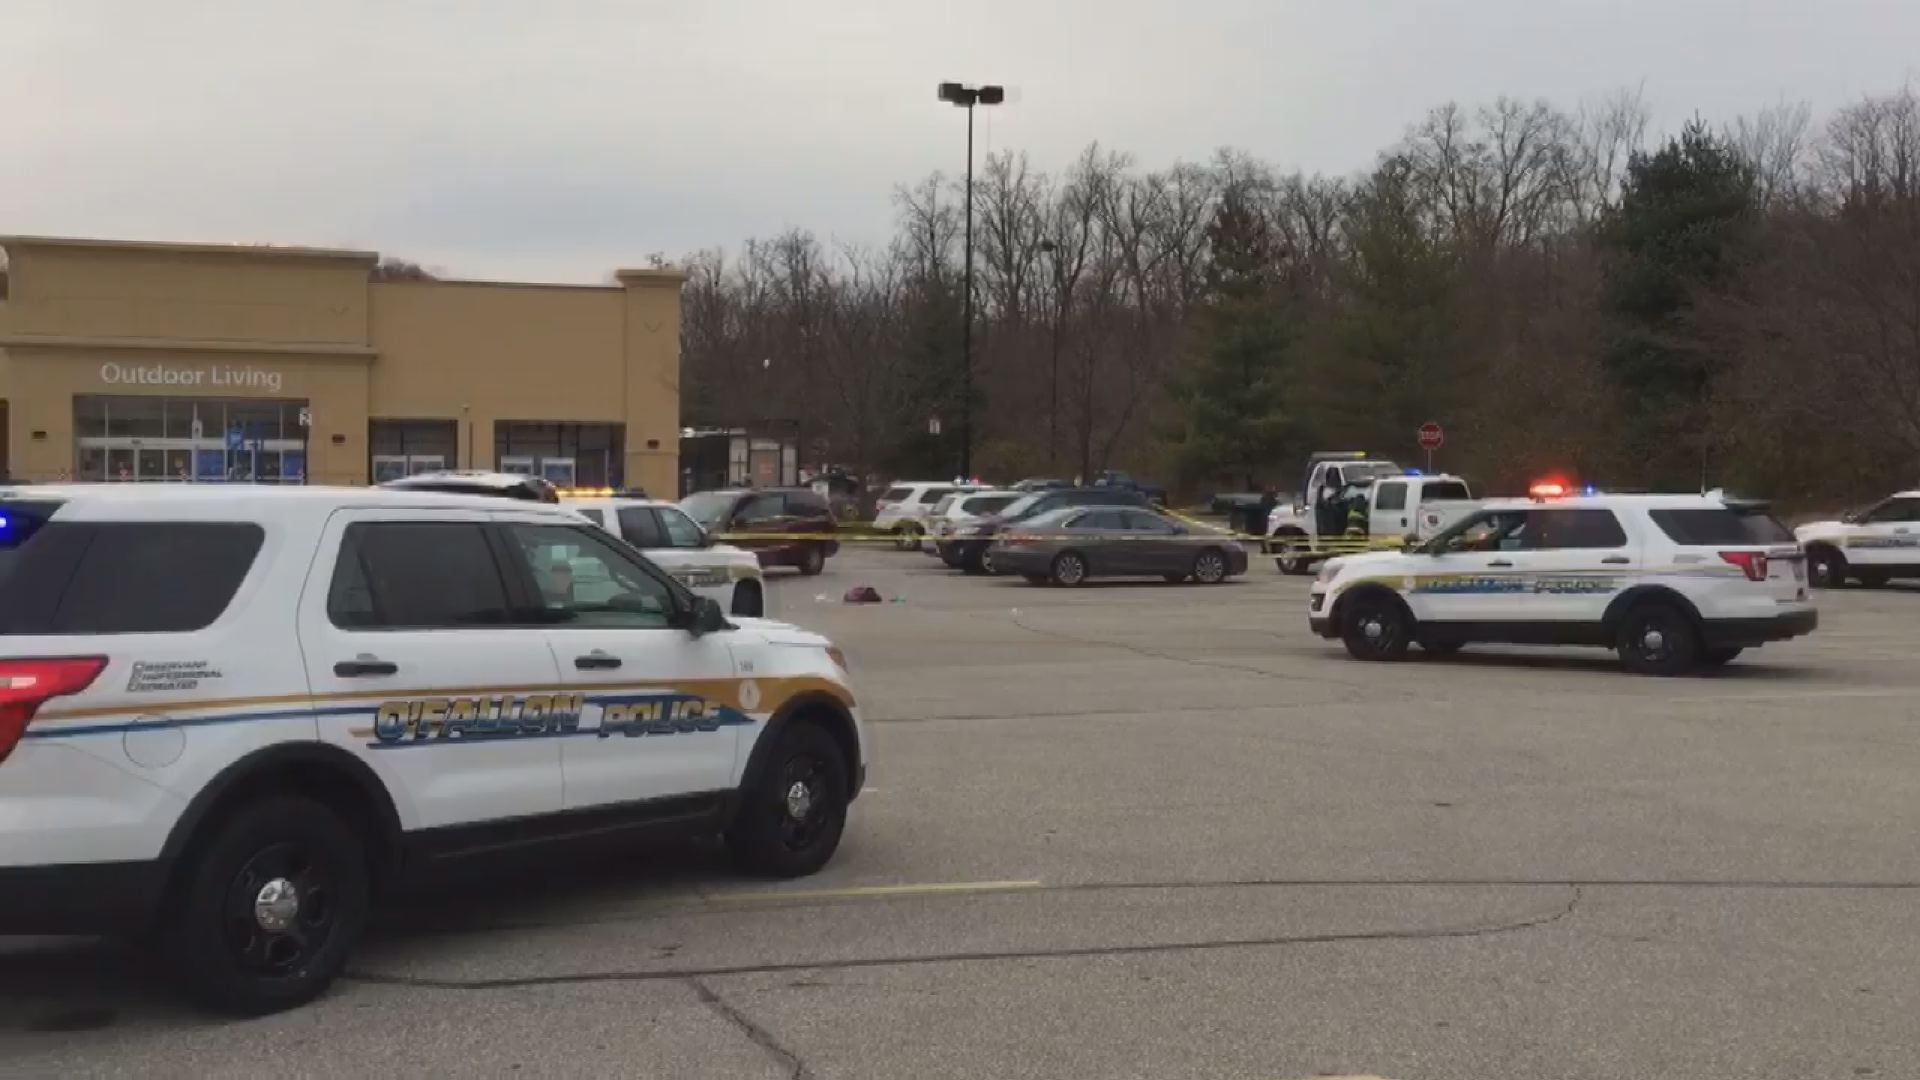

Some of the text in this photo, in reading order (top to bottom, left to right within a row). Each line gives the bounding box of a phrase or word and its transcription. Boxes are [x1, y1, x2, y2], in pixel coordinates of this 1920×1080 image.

[101, 362, 283, 392] Outdoor Living
[374, 692, 722, 741] O'FALLON POLICE
